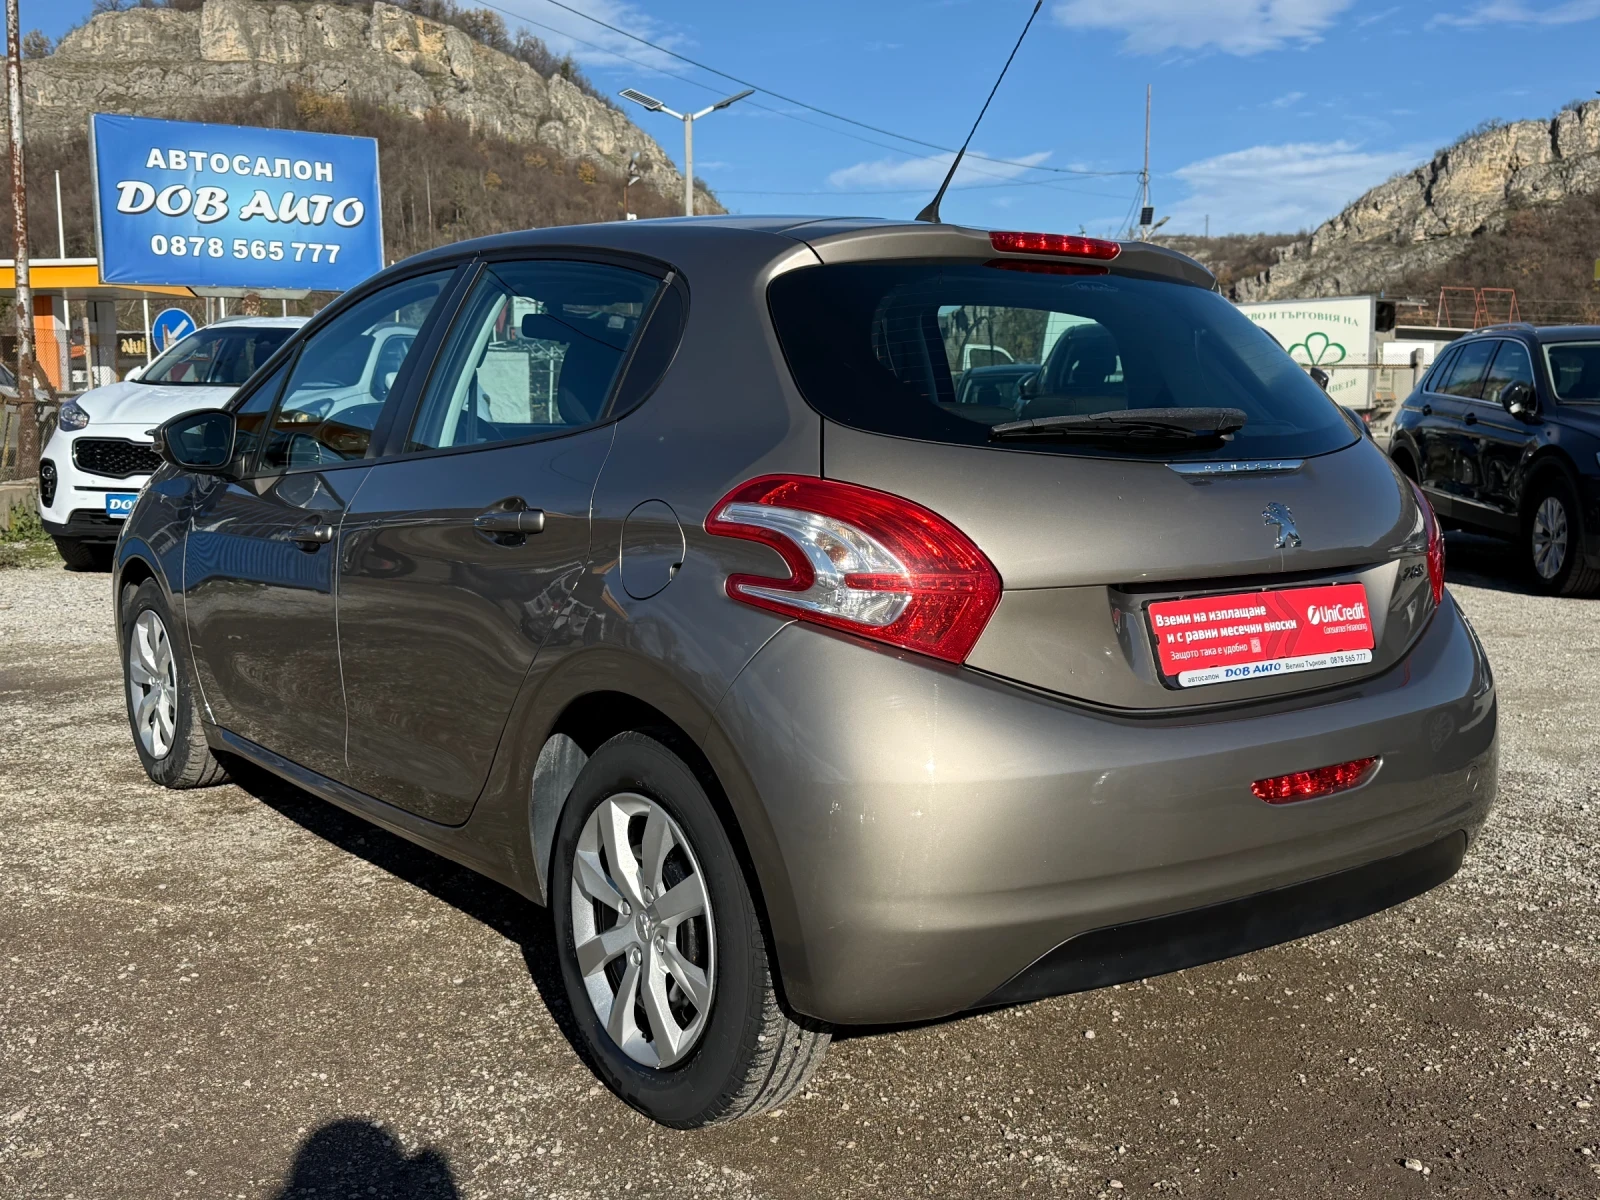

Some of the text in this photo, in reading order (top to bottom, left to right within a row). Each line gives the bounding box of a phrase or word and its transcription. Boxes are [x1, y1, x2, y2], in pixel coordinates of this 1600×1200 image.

[145, 147, 334, 182] АВТОСАЛОН
[116, 180, 365, 227] DOB AUTO
[150, 234, 341, 264] 0878 565 777
[1155, 605, 1267, 628] Вземи на изплащане
[1319, 602, 1366, 623] UniCredit
[1167, 619, 1297, 645] и с равни месечни вноски
[1170, 649, 1199, 661] Защото
[1200, 646, 1217, 657] така
[1223, 642, 1248, 656] удобно
[1224, 665, 1251, 679] DOB
[1330, 655, 1345, 665] 0878
[1345, 653, 1356, 664] 565
[1356, 652, 1367, 662] 777
